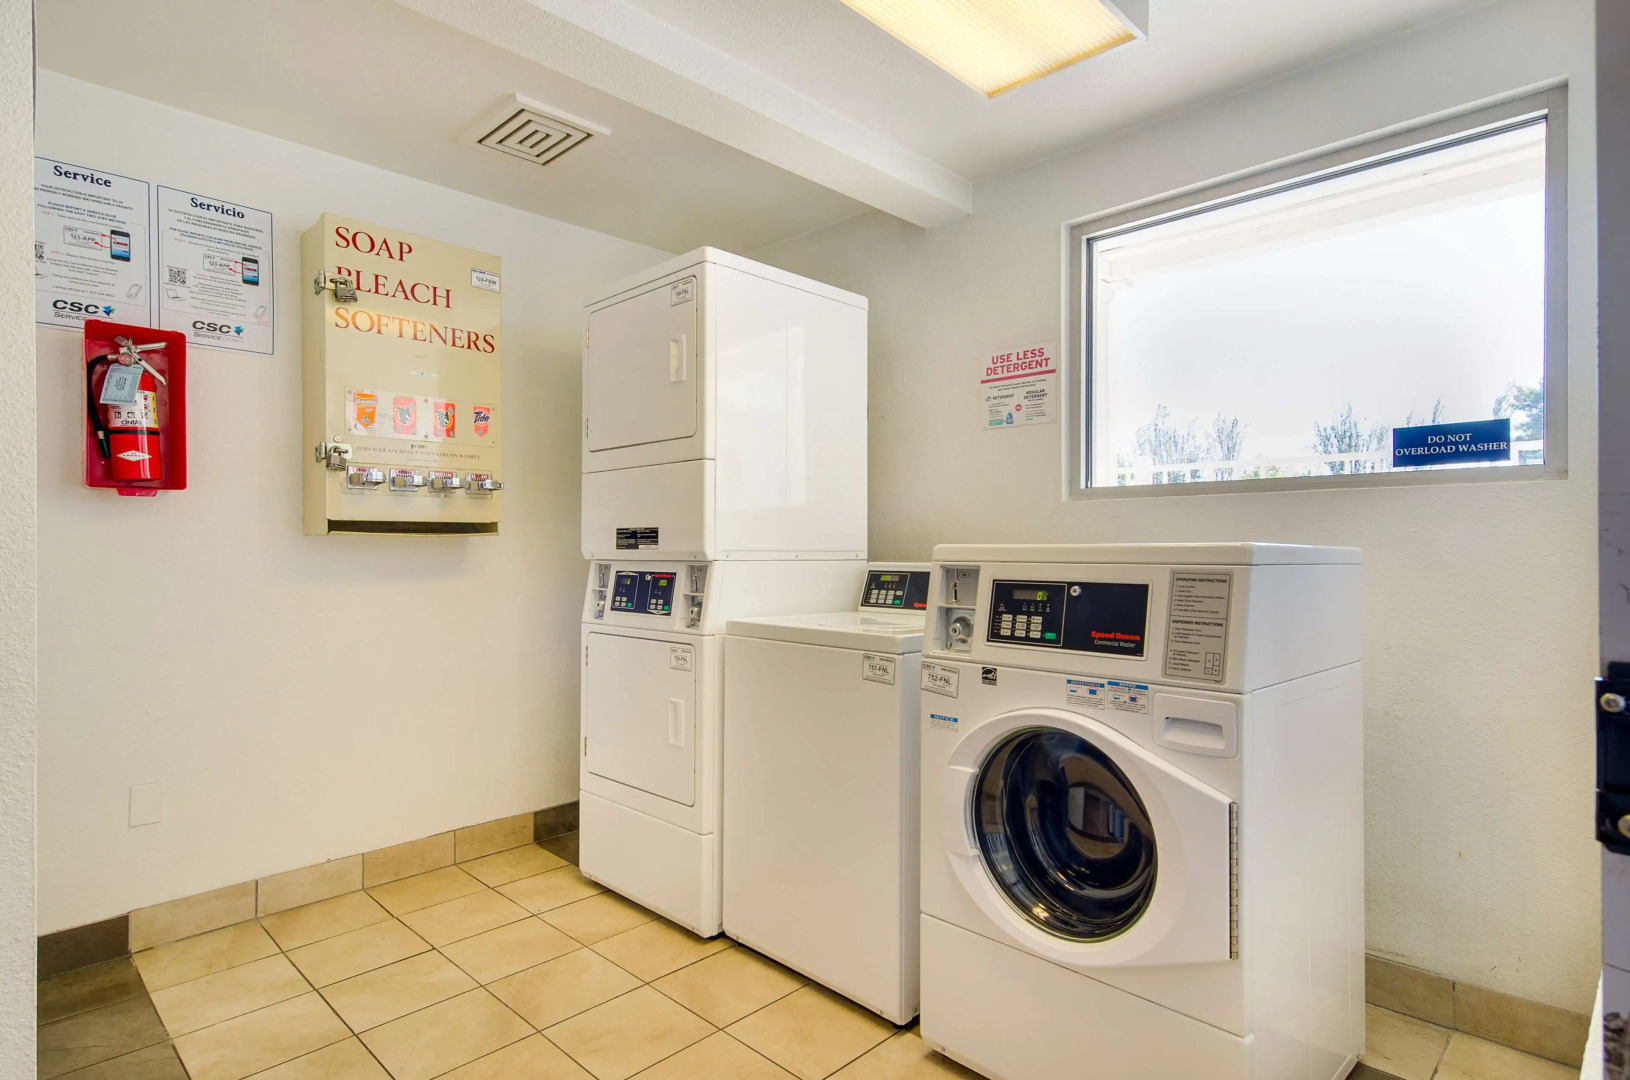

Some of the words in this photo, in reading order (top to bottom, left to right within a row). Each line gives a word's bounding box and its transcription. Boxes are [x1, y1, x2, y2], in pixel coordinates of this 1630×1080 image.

[53, 165, 112, 187] Service
[190, 197, 245, 219] Servicio
[335, 226, 413, 262] SOAP
[52, 300, 100, 314] CSC
[192, 320, 232, 334] CSC
[334, 306, 495, 354] SOFTENERS
[992, 353, 1012, 365] USE
[1016, 348, 1045, 361] LESS
[986, 358, 1050, 376] DETERGENT
[396, 406, 411, 425] Tide
[473, 411, 490, 424] Tide
[1428, 436, 1445, 444] DO
[1447, 433, 1473, 442] NOT
[1395, 445, 1456, 456] OVERLOAD
[1458, 442, 1508, 452] WASHER
[1091, 630, 1114, 638] Speed
[1116, 632, 1140, 640] Queen
[868, 664, 889, 674] 751-FNL
[928, 674, 952, 685] 752-FNL
